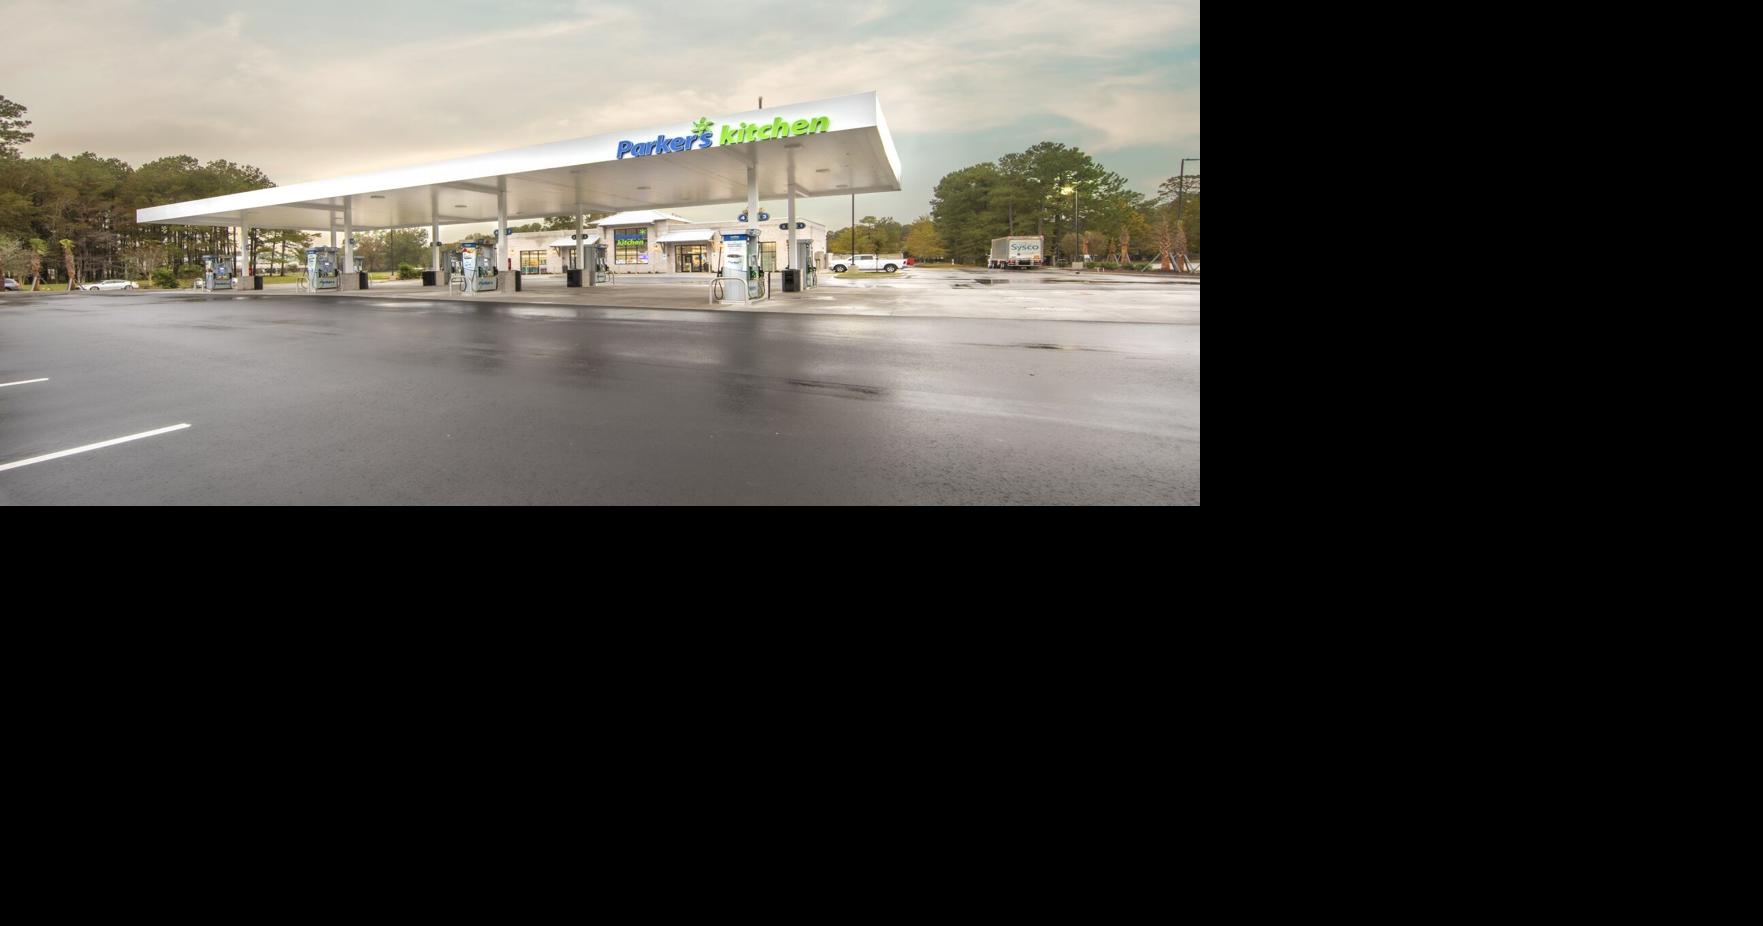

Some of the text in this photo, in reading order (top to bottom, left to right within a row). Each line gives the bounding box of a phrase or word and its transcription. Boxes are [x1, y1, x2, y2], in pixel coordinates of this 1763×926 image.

[617, 116, 830, 160] Parker's kitchen
[617, 239, 644, 247] kitchen
[1011, 243, 1039, 251] Sysco
